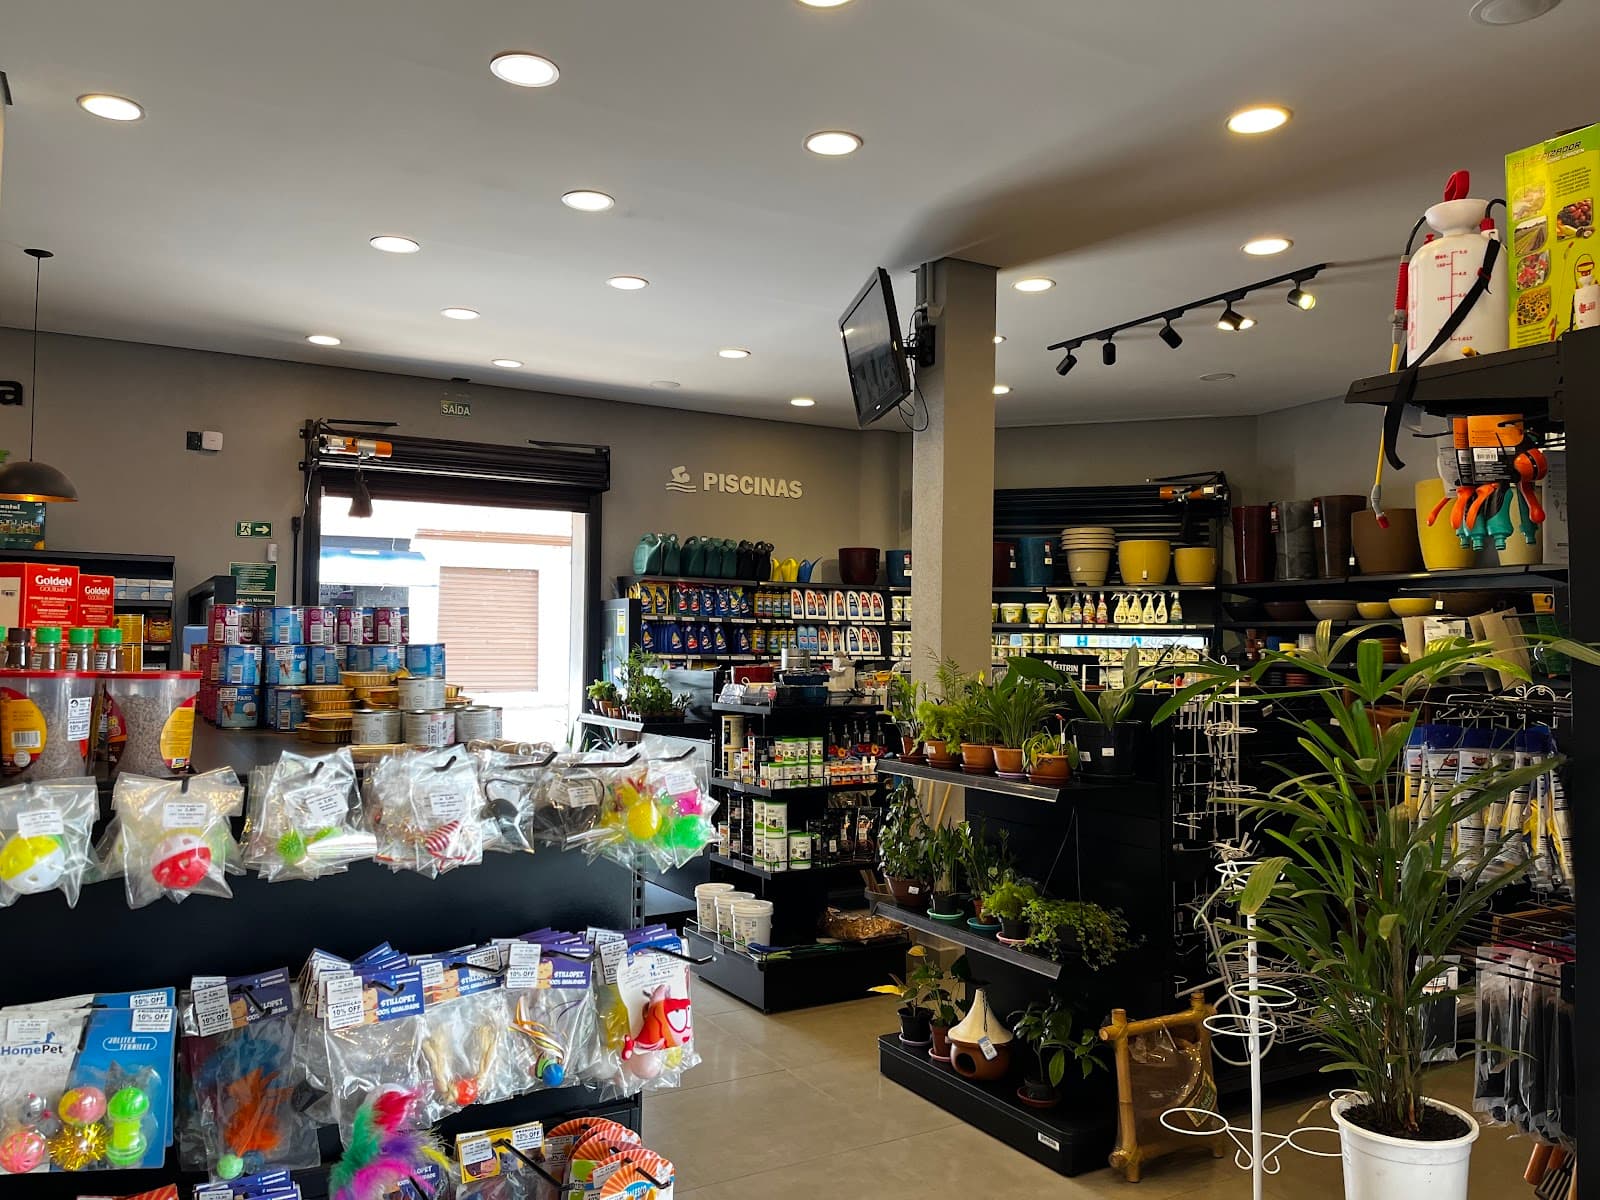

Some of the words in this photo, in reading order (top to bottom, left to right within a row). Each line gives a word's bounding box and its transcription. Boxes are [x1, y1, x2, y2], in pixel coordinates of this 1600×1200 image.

[442, 403, 470, 415] SAÍDA
[703, 472, 803, 499] PISCINAS
[348, 1004, 361, 1012] OFF
[202, 1016, 216, 1025] 10%
[217, 1012, 229, 1020] OFF
[0, 1044, 63, 1056] HomePet
